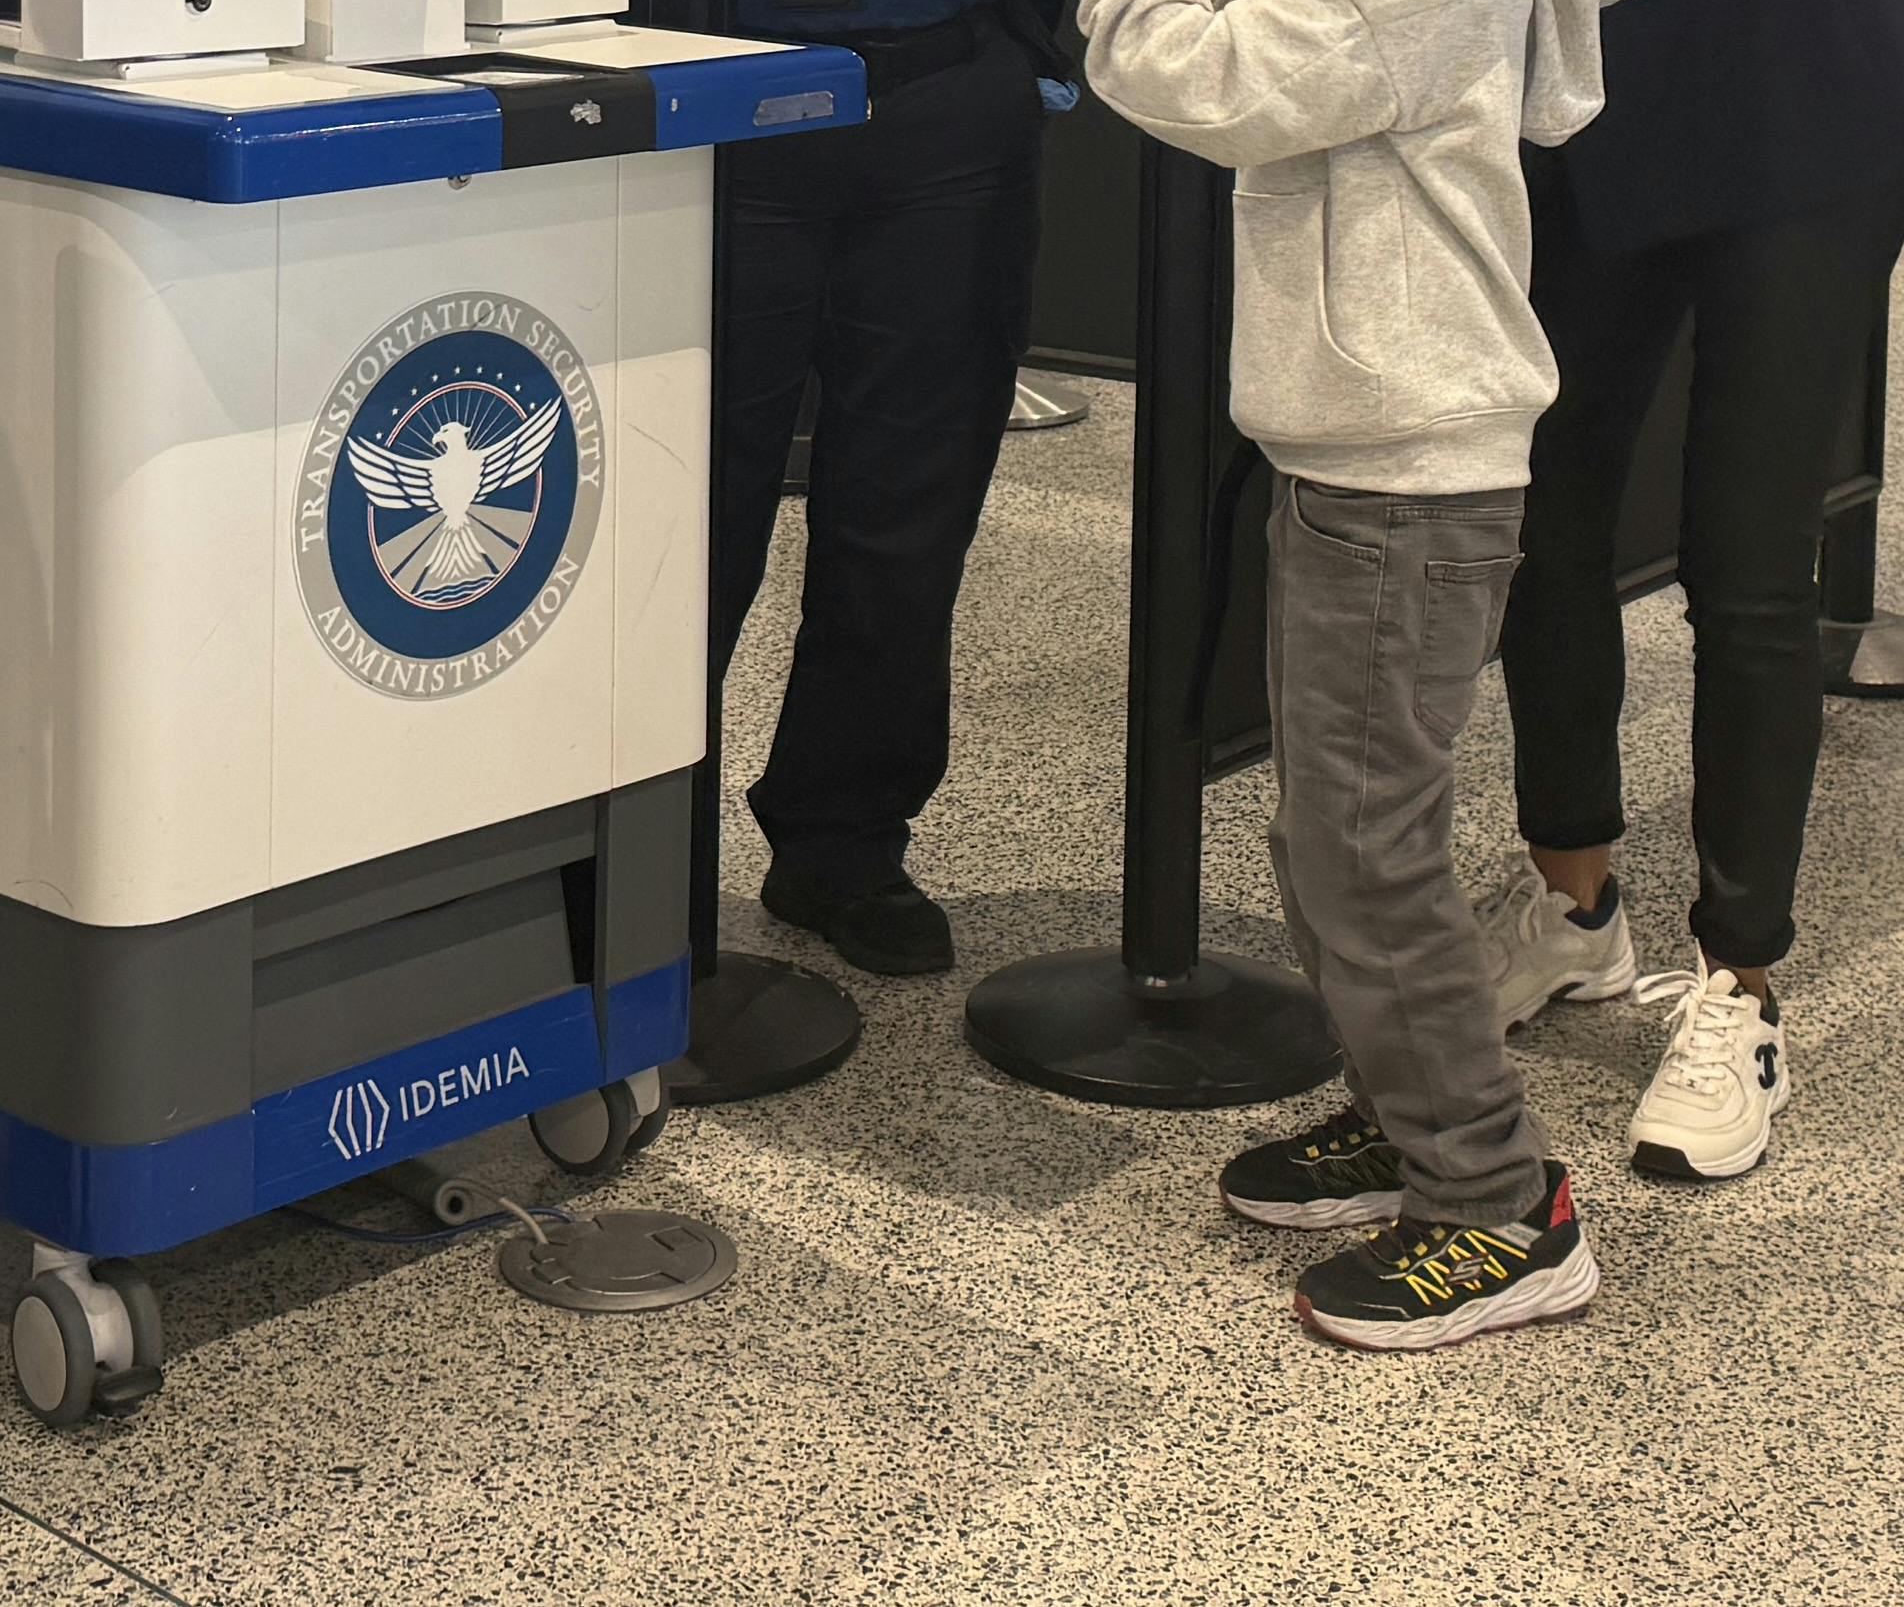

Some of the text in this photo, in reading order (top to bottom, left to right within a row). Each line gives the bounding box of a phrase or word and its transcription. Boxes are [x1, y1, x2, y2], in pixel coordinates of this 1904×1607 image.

[301, 298, 601, 553] TRANSPORTATION SECURITY
[317, 553, 580, 694] ADMINISTRATION
[399, 1047, 530, 1122] IDEMIA
